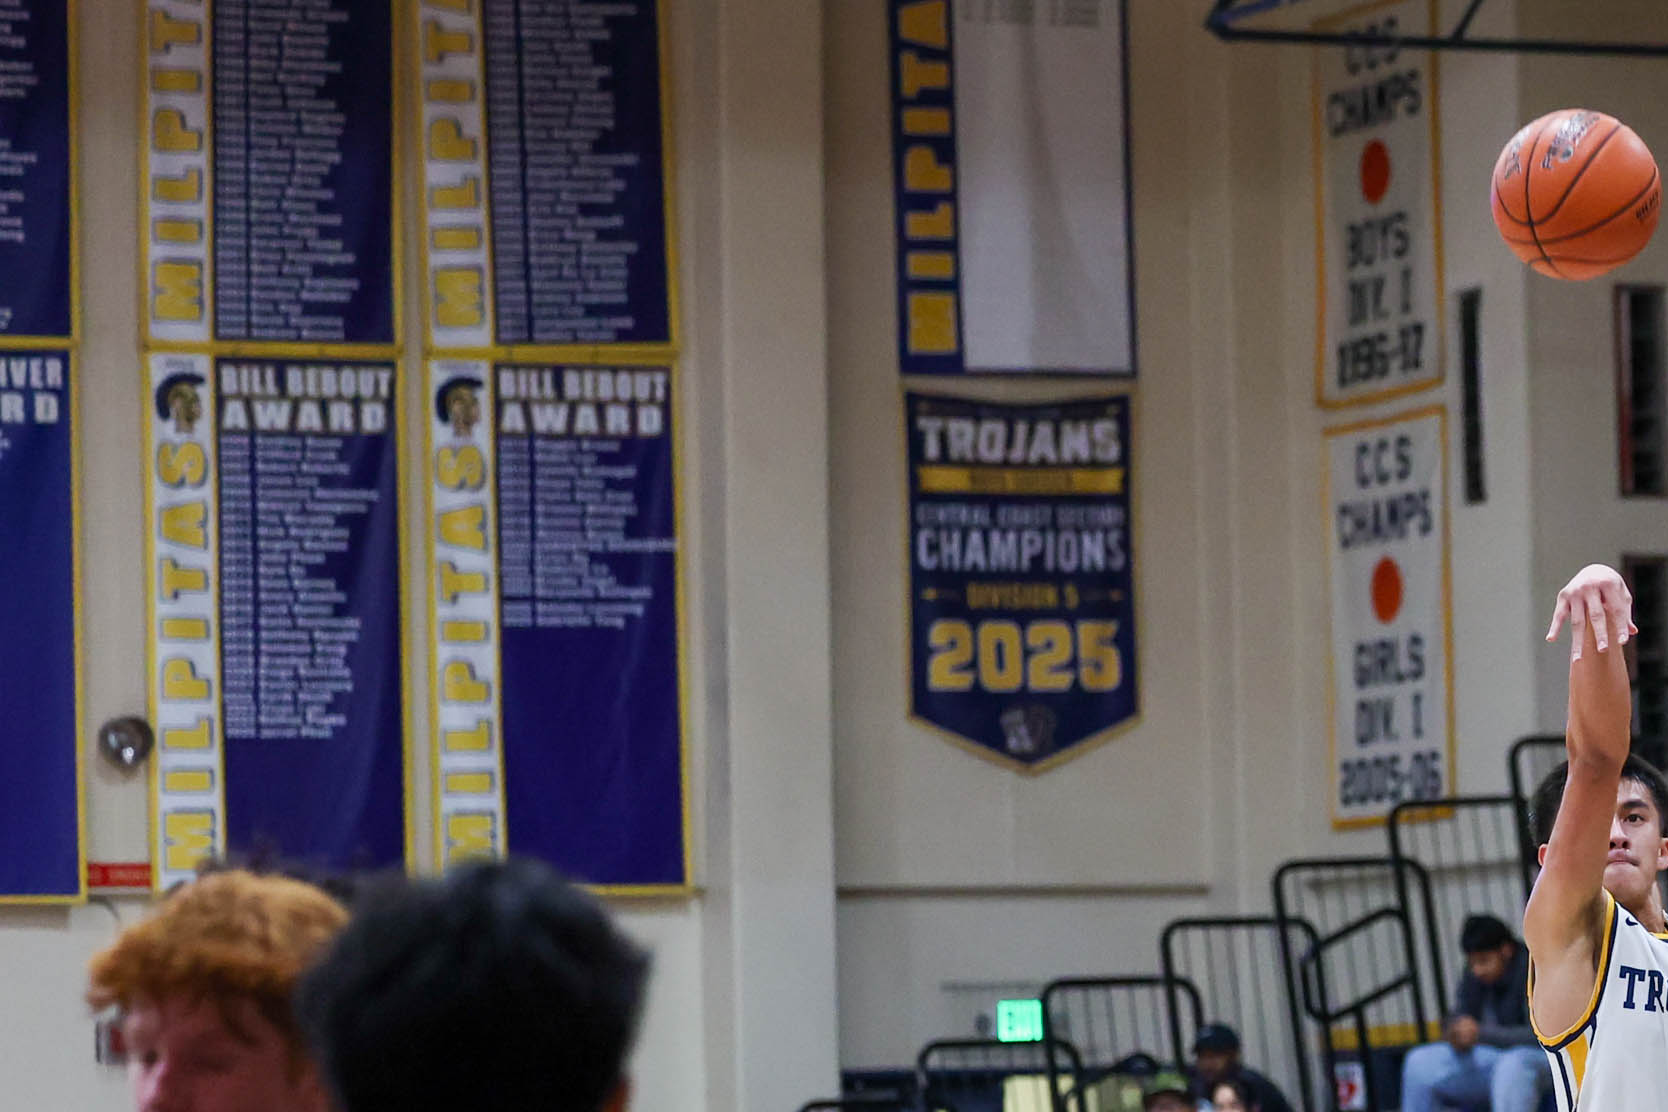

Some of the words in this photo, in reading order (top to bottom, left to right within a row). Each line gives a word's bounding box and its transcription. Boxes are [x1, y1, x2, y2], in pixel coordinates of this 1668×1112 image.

[1326, 68, 1422, 138] CHAMPS
[422, 0, 487, 328] MILPIT
[1347, 210, 1411, 270] BOYS
[220, 363, 279, 396] BILL
[499, 367, 556, 399] BILL
[221, 398, 388, 434] AWARD
[501, 401, 664, 438] AWARD
[916, 415, 1122, 465] TROJANS
[1354, 434, 1412, 490] CCS
[1336, 487, 1433, 551] CHAMPS
[916, 527, 1126, 573] CHAMPIONS
[157, 441, 215, 871] MILPITAS
[437, 445, 496, 866] MILPITAS
[926, 618, 1124, 693] 2025
[1355, 633, 1425, 688] GIRLS
